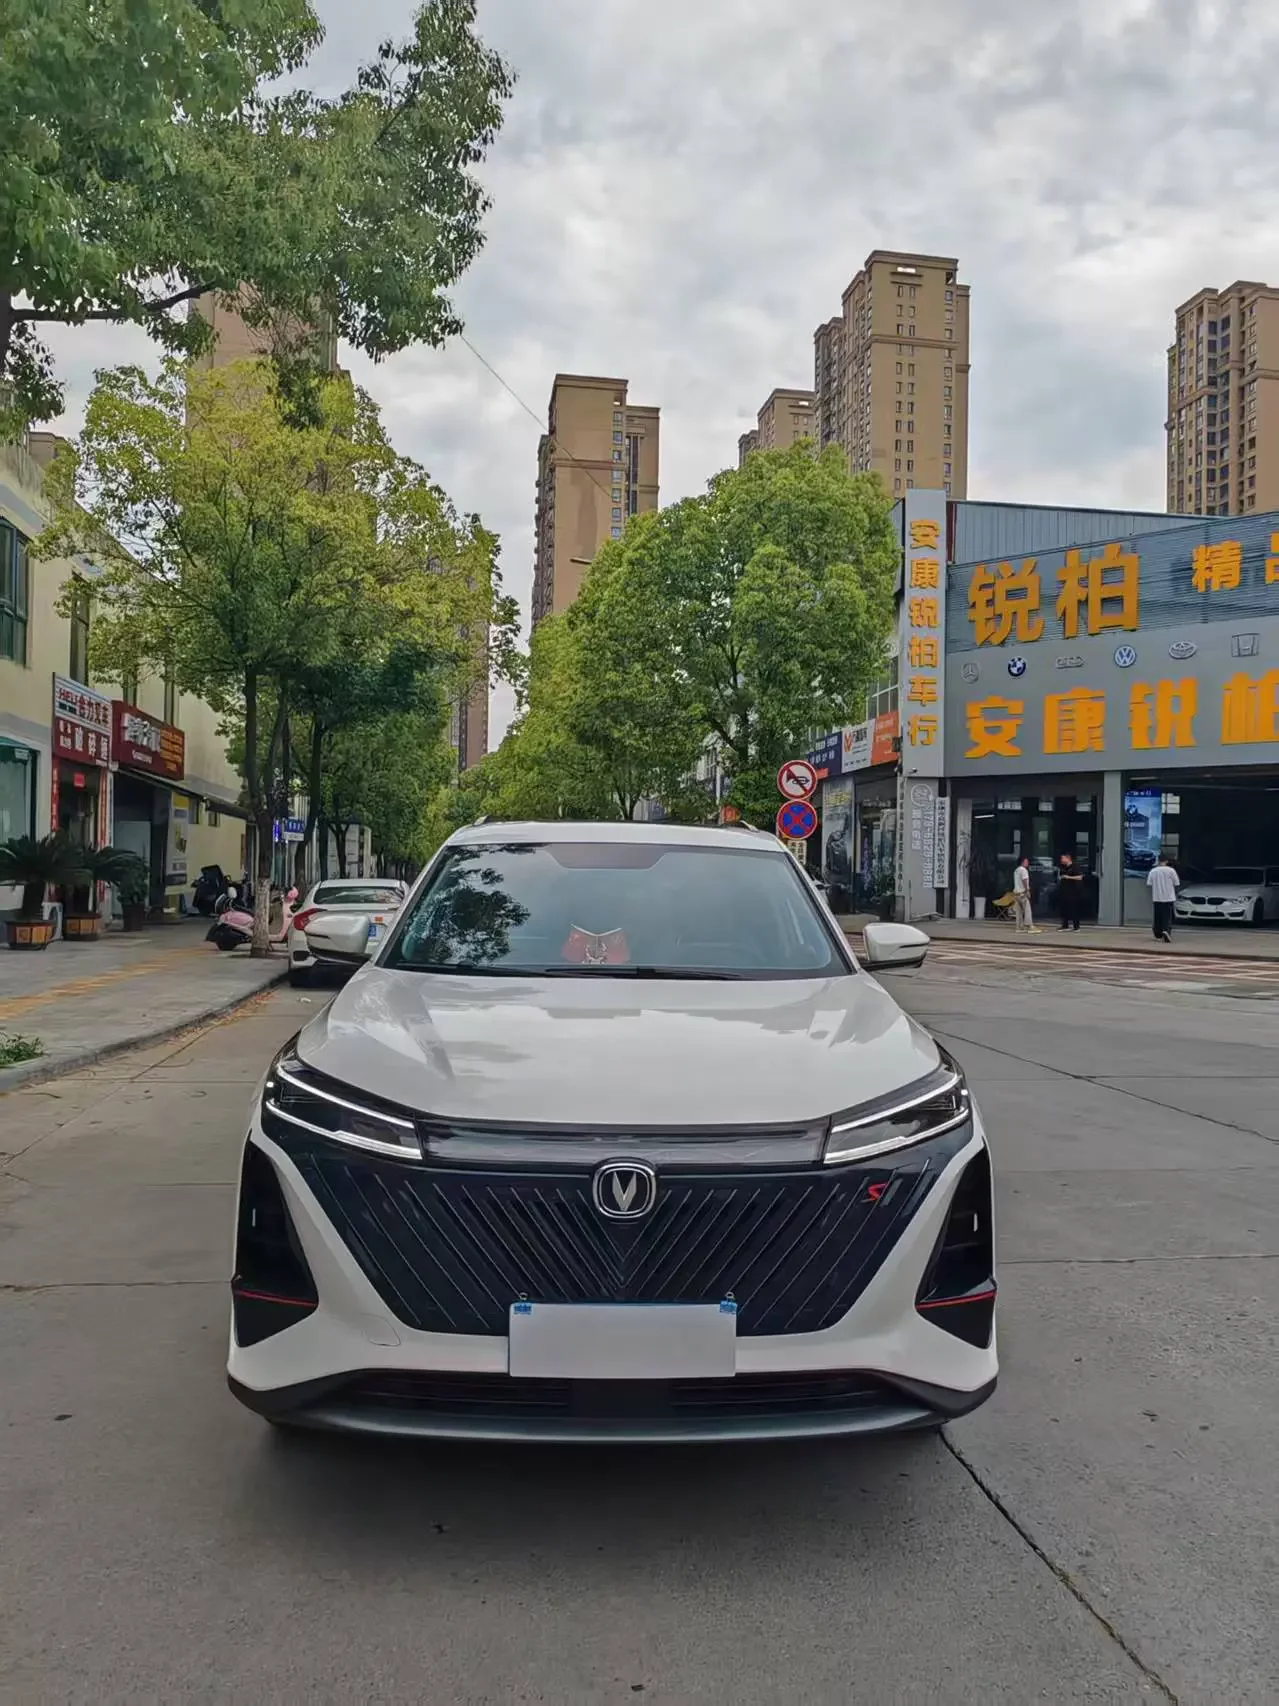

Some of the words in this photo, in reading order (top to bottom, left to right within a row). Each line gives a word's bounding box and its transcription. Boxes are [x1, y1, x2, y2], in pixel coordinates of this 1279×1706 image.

[908, 519, 939, 747] 安康锐柏车行
[967, 543, 1141, 648] 锐柏
[1191, 531, 1279, 592] 精
